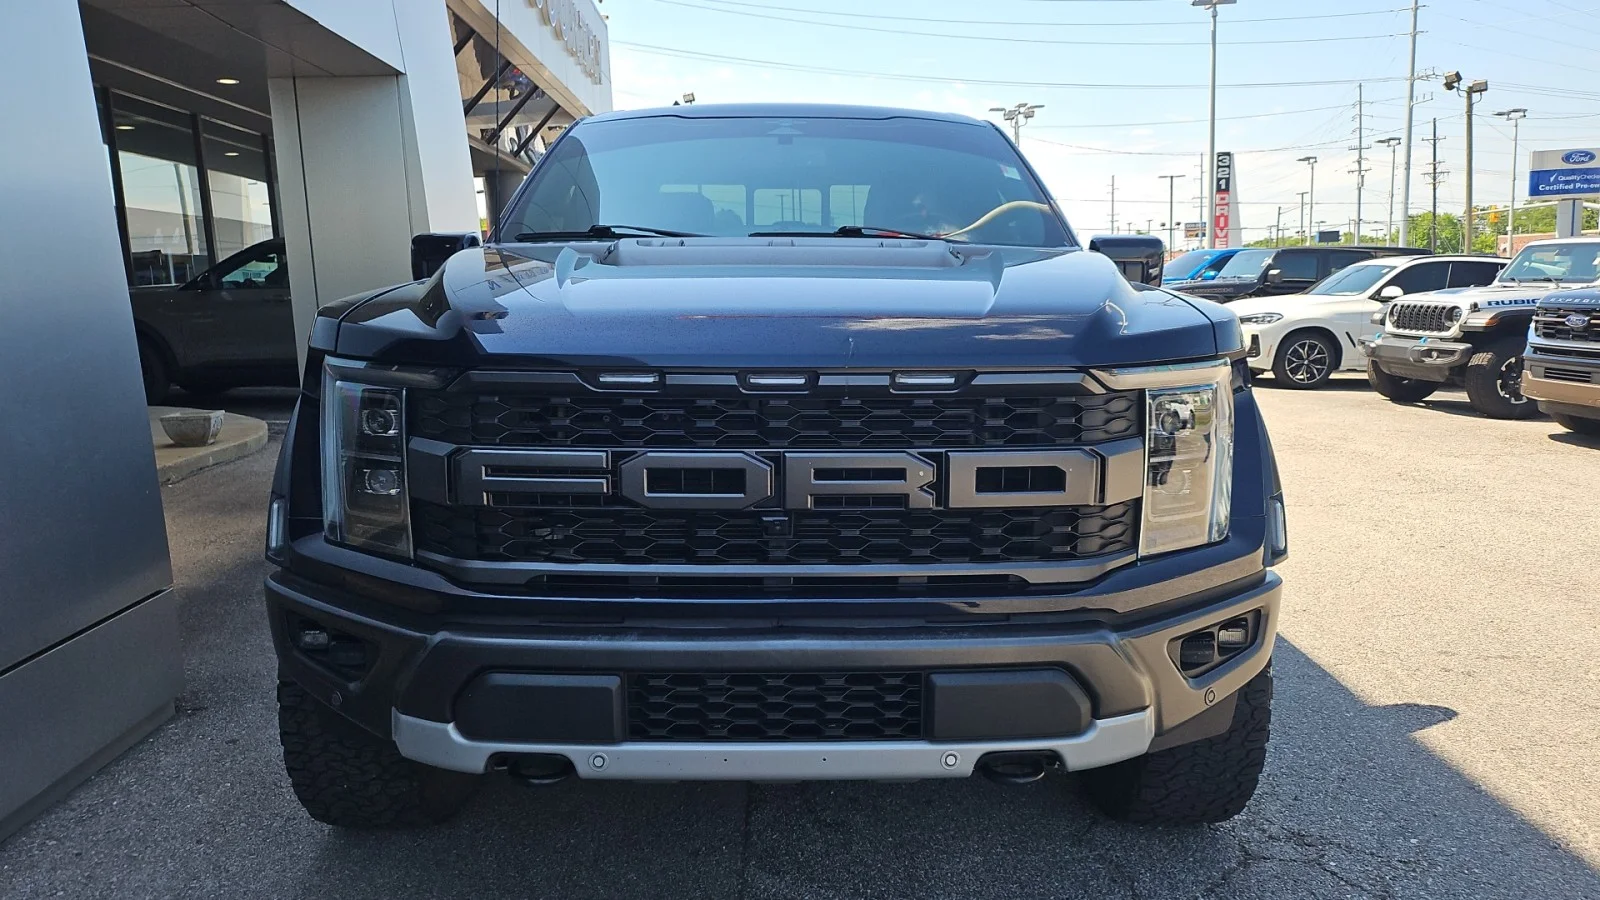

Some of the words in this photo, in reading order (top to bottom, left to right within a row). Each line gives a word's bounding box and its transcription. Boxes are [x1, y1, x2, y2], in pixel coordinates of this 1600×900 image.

[1217, 155, 1230, 189] 321
[1570, 152, 1591, 162] Ford
[1539, 183, 1574, 191] Certified
[1215, 194, 1229, 248] DRIVE
[451, 446, 1102, 510] FORD
